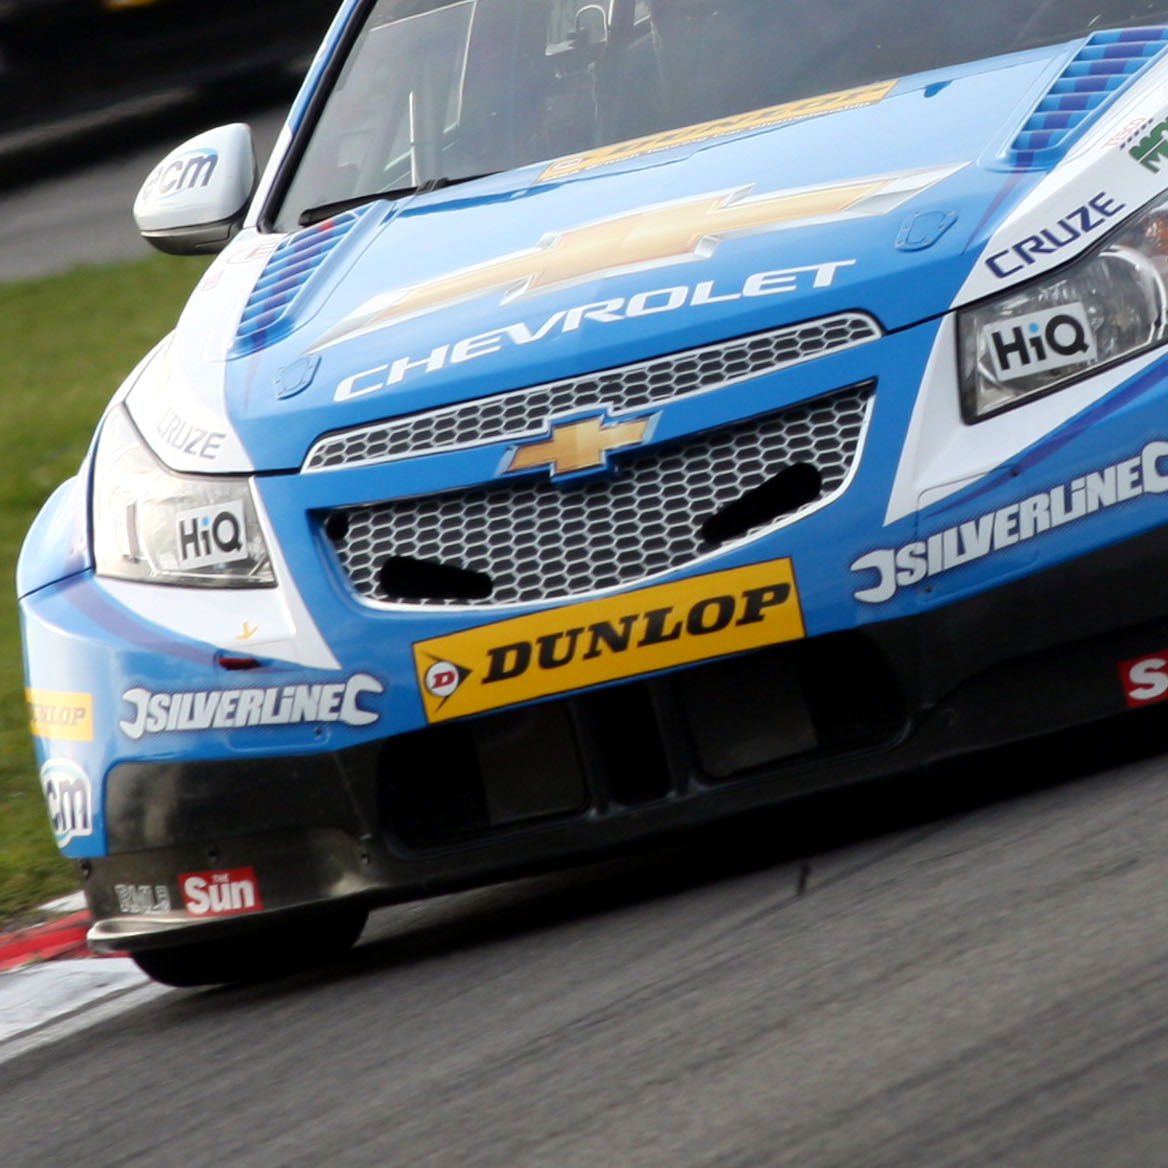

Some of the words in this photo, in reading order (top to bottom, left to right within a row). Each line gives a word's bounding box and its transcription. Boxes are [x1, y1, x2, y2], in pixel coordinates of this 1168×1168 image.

[985, 191, 1126, 279] CRUZE
[333, 258, 857, 403] CHEVROLET
[992, 313, 1090, 372] HiQ
[179, 510, 242, 561] HiQ
[481, 582, 791, 685] DUNLOP
[184, 876, 255, 915] Sun
